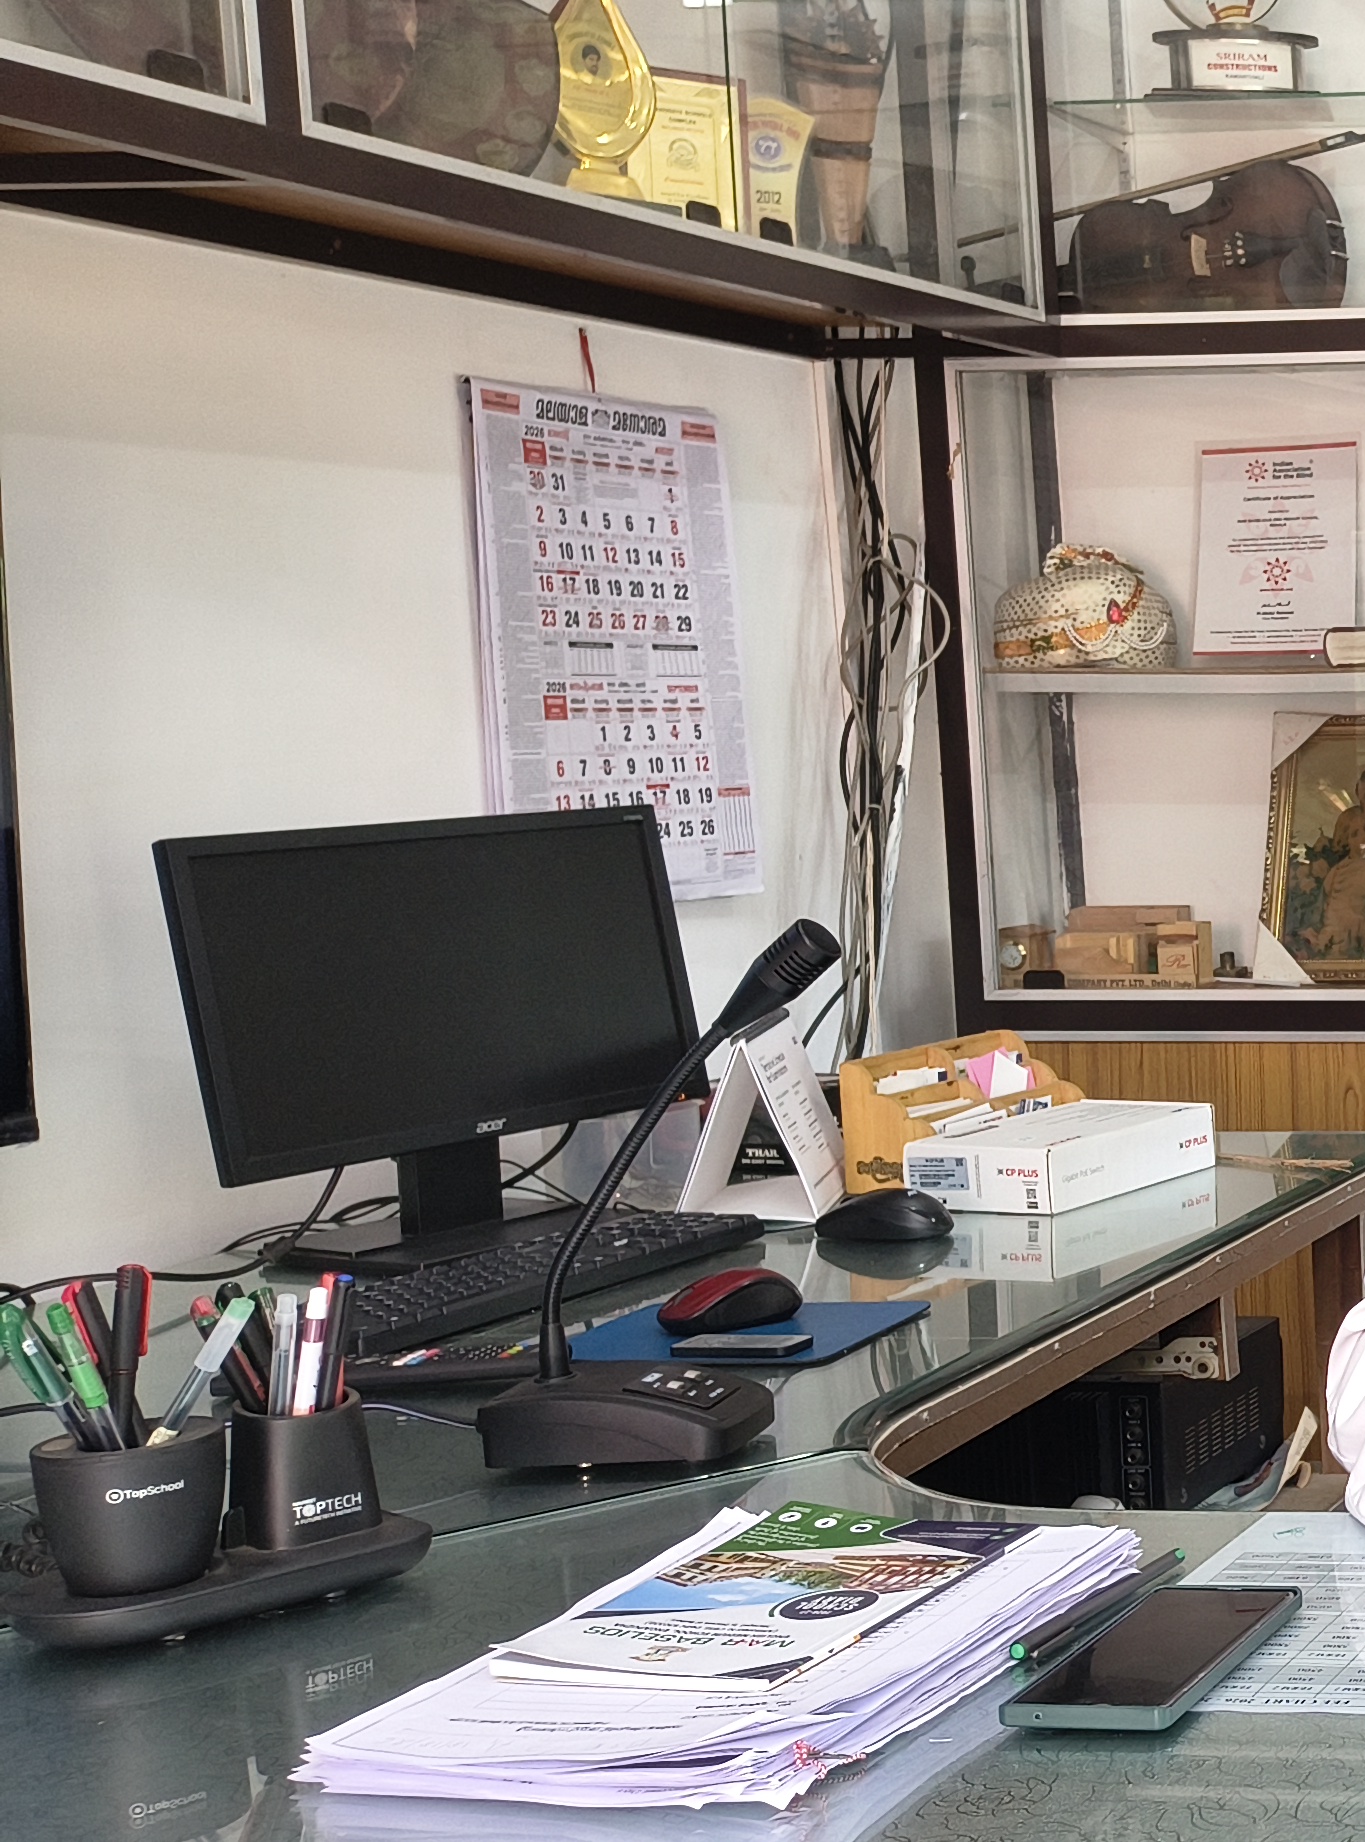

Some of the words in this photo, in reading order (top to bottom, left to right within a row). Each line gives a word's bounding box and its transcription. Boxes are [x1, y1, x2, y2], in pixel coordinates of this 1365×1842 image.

[1216, 52, 1267, 62] SRIRAM
[1207, 63, 1278, 72] CONSTRUCTIONS
[756, 190, 781, 204] 2012
[536, 398, 589, 427] മലയാള
[612, 411, 666, 437] മനോരമ
[524, 425, 544, 438] 2026
[529, 471, 545, 489] 30
[551, 473, 566, 492] 31
[667, 488, 675, 503] 1
[536, 506, 544, 523] 2
[559, 508, 567, 525] 3
[580, 511, 588, 527] 4
[602, 513, 611, 529] 5
[625, 515, 634, 531] 6
[648, 517, 655, 533] 7
[670, 520, 679, 535] 8
[539, 541, 547, 557] 9
[558, 542, 574, 560] 10
[581, 544, 595, 561] 11
[603, 547, 618, 563] 12
[626, 548, 641, 565] 13
[648, 550, 662, 566] 14
[671, 552, 685, 568] 15
[539, 575, 554, 592] 16
[562, 577, 576, 594] 17
[585, 578, 600, 595] 18
[607, 580, 622, 596] 19
[629, 581, 644, 597] 20
[652, 582, 665, 599] 21
[673, 584, 689, 600] 22
[542, 610, 557, 627] 23
[565, 611, 580, 627] 24
[588, 612, 602, 628] 25
[610, 613, 625, 630] 26
[633, 614, 647, 630] 27
[677, 616, 692, 632] 29
[546, 682, 567, 693] 2026
[600, 726, 606, 742] 1
[623, 726, 632, 741] 2
[647, 725, 655, 741] 3
[670, 725, 680, 740] 4
[693, 725, 702, 740] 5
[556, 761, 564, 777] 6
[579, 759, 587, 776] 7
[603, 759, 612, 776] 8
[627, 758, 636, 774] 9
[648, 757, 663, 774] 10
[672, 757, 686, 773] 11
[695, 756, 710, 772] 12
[556, 795, 571, 811] 13
[580, 794, 595, 810] 14
[605, 792, 620, 808] 15
[628, 791, 644, 807] 16
[653, 790, 667, 806] 17
[676, 789, 690, 805] 18
[698, 787, 713, 803] 19
[657, 823, 671, 839] 24
[679, 821, 693, 837] 25
[700, 820, 715, 835] 26
[1151, 978, 1171, 988] Delhi
[476, 1118, 507, 1133] acer
[1184, 1140, 1192, 1148] CP
[1193, 1135, 1208, 1146] PLUS
[746, 1148, 779, 1158] THAR
[1006, 1169, 1016, 1177] CP
[1018, 1169, 1039, 1178] PLUS
[124, 1479, 184, 1499] TopSchool
[294, 1492, 362, 1518] TOPTECH
[795, 1602, 859, 1611] SCHOOL
[583, 1626, 714, 1645] BASELIOS
[722, 1639, 795, 1648] MAR
